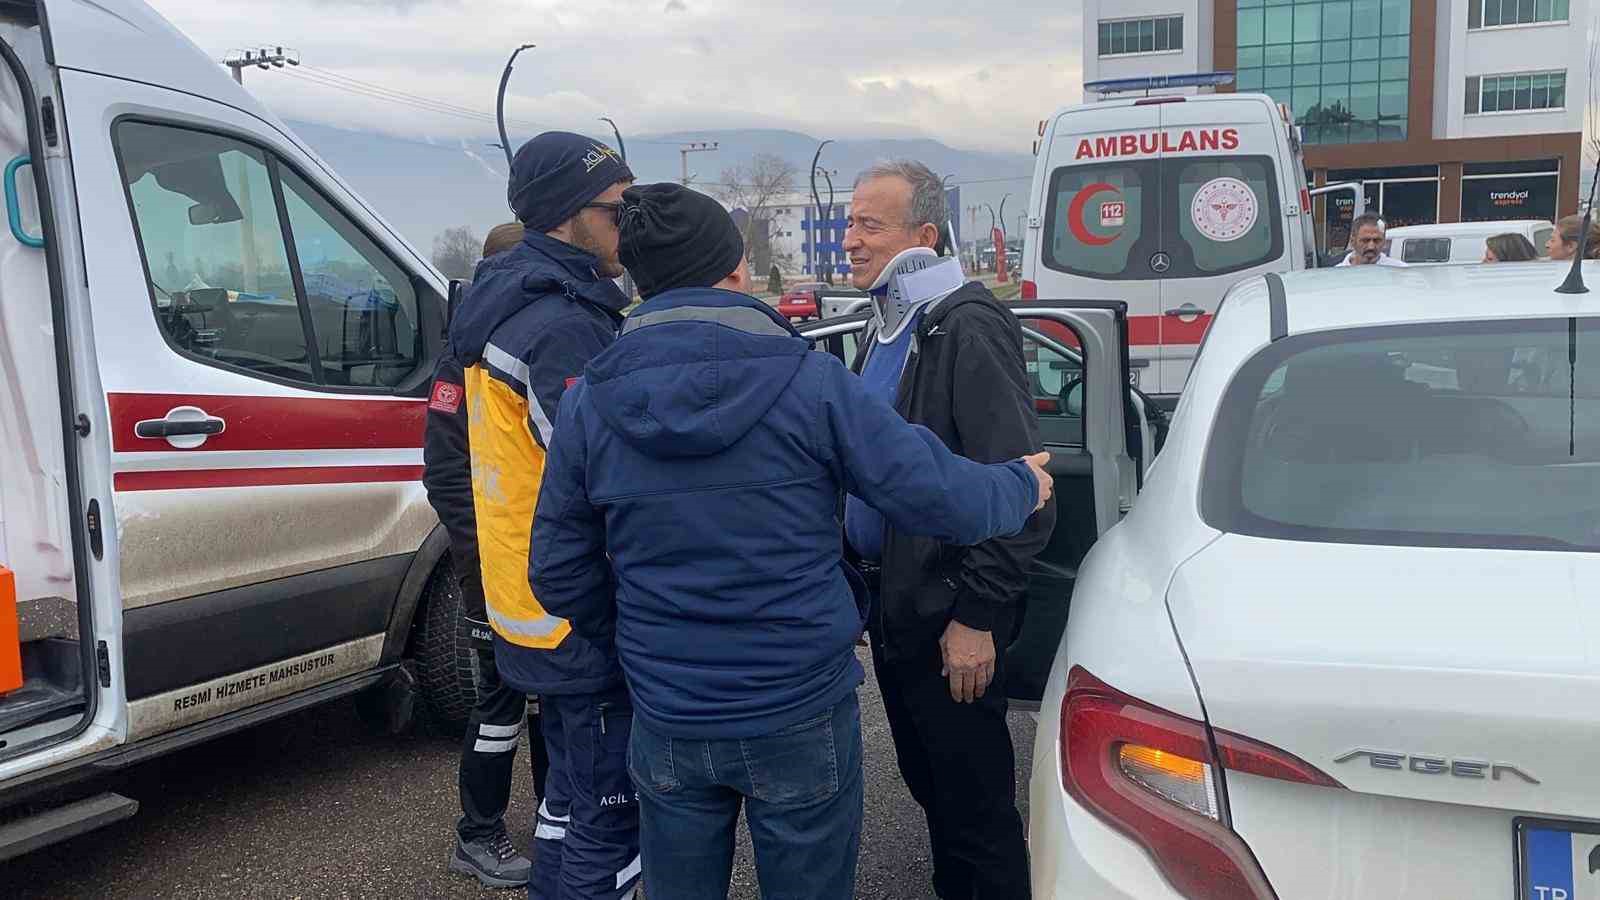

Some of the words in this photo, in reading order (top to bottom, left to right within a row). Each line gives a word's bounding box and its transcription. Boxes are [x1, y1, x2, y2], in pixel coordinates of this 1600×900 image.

[1075, 129, 1239, 160] AMBULANS
[1490, 190, 1529, 200] trendyol
[1103, 204, 1122, 218] 112
[174, 688, 212, 711] RESMİ
[216, 674, 266, 699] HİZMETE
[269, 653, 335, 682] MAHSUSTUR
